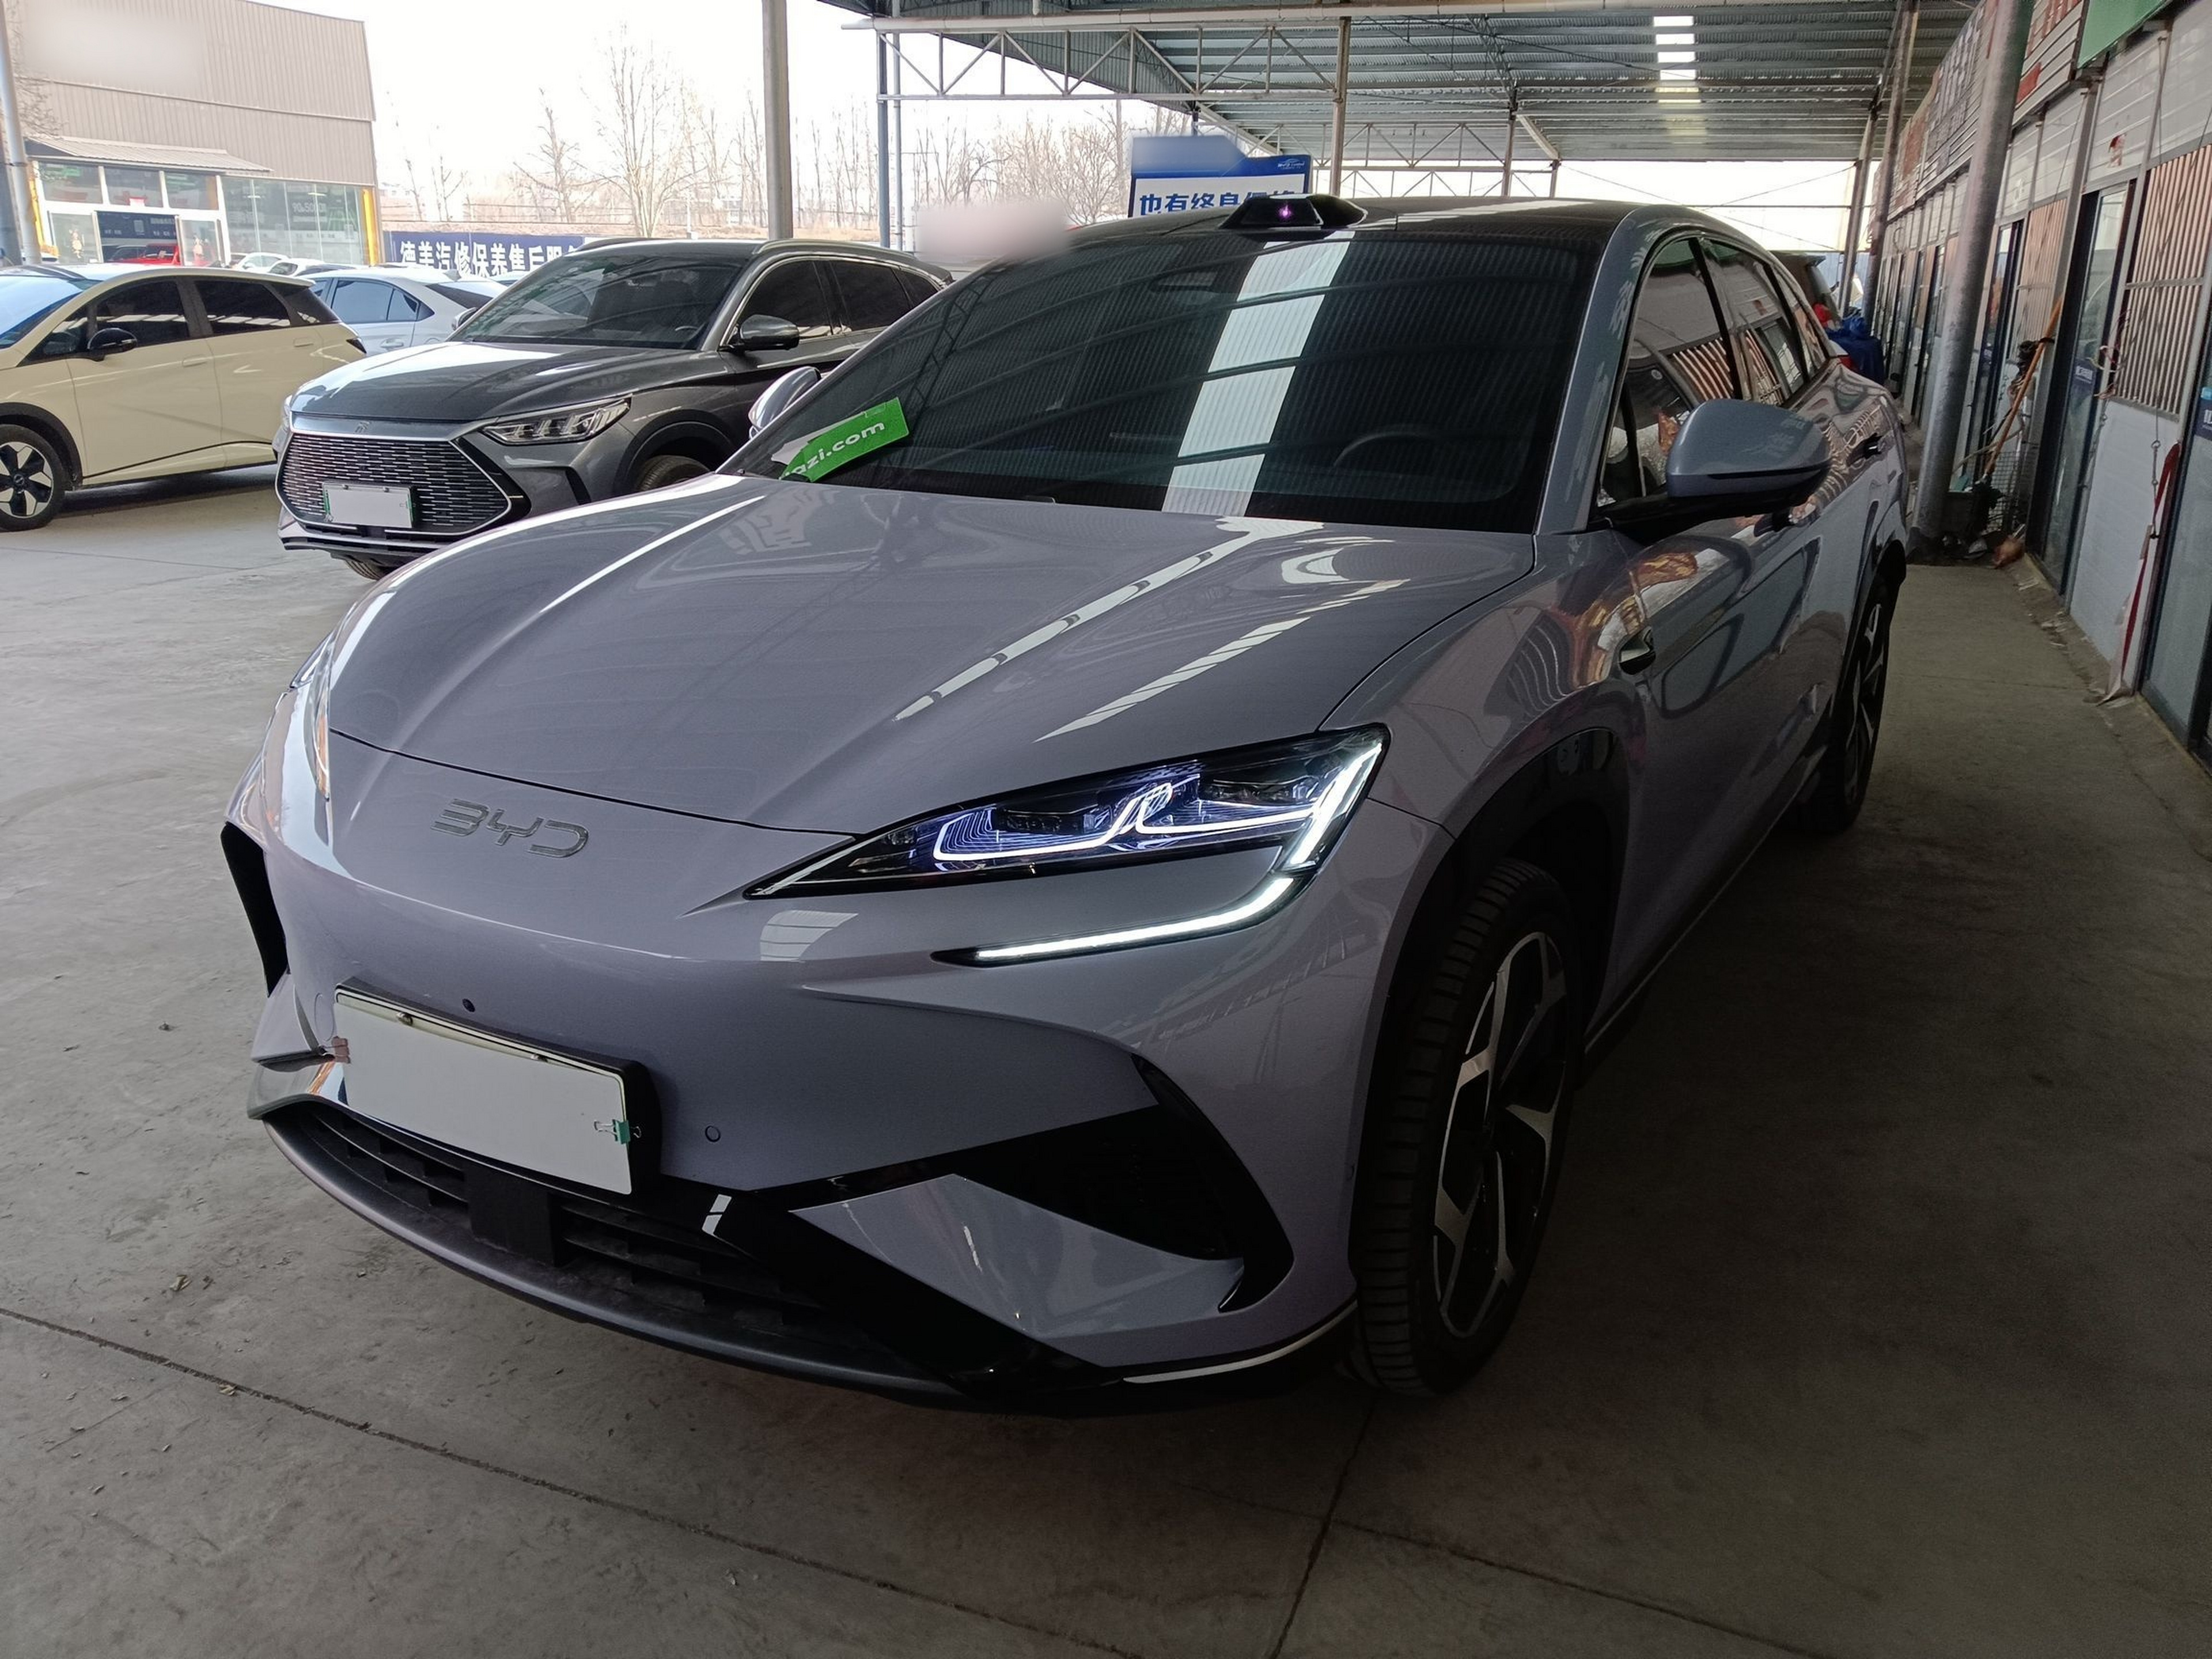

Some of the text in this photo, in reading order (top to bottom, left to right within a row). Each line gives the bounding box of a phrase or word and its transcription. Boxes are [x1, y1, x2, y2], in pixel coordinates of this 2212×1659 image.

[1139, 190, 1295, 216] 也有终身
[400, 240, 578, 277] 德美汽修保养售后服
[785, 421, 885, 476] azi.com
[431, 798, 589, 858] BYD
